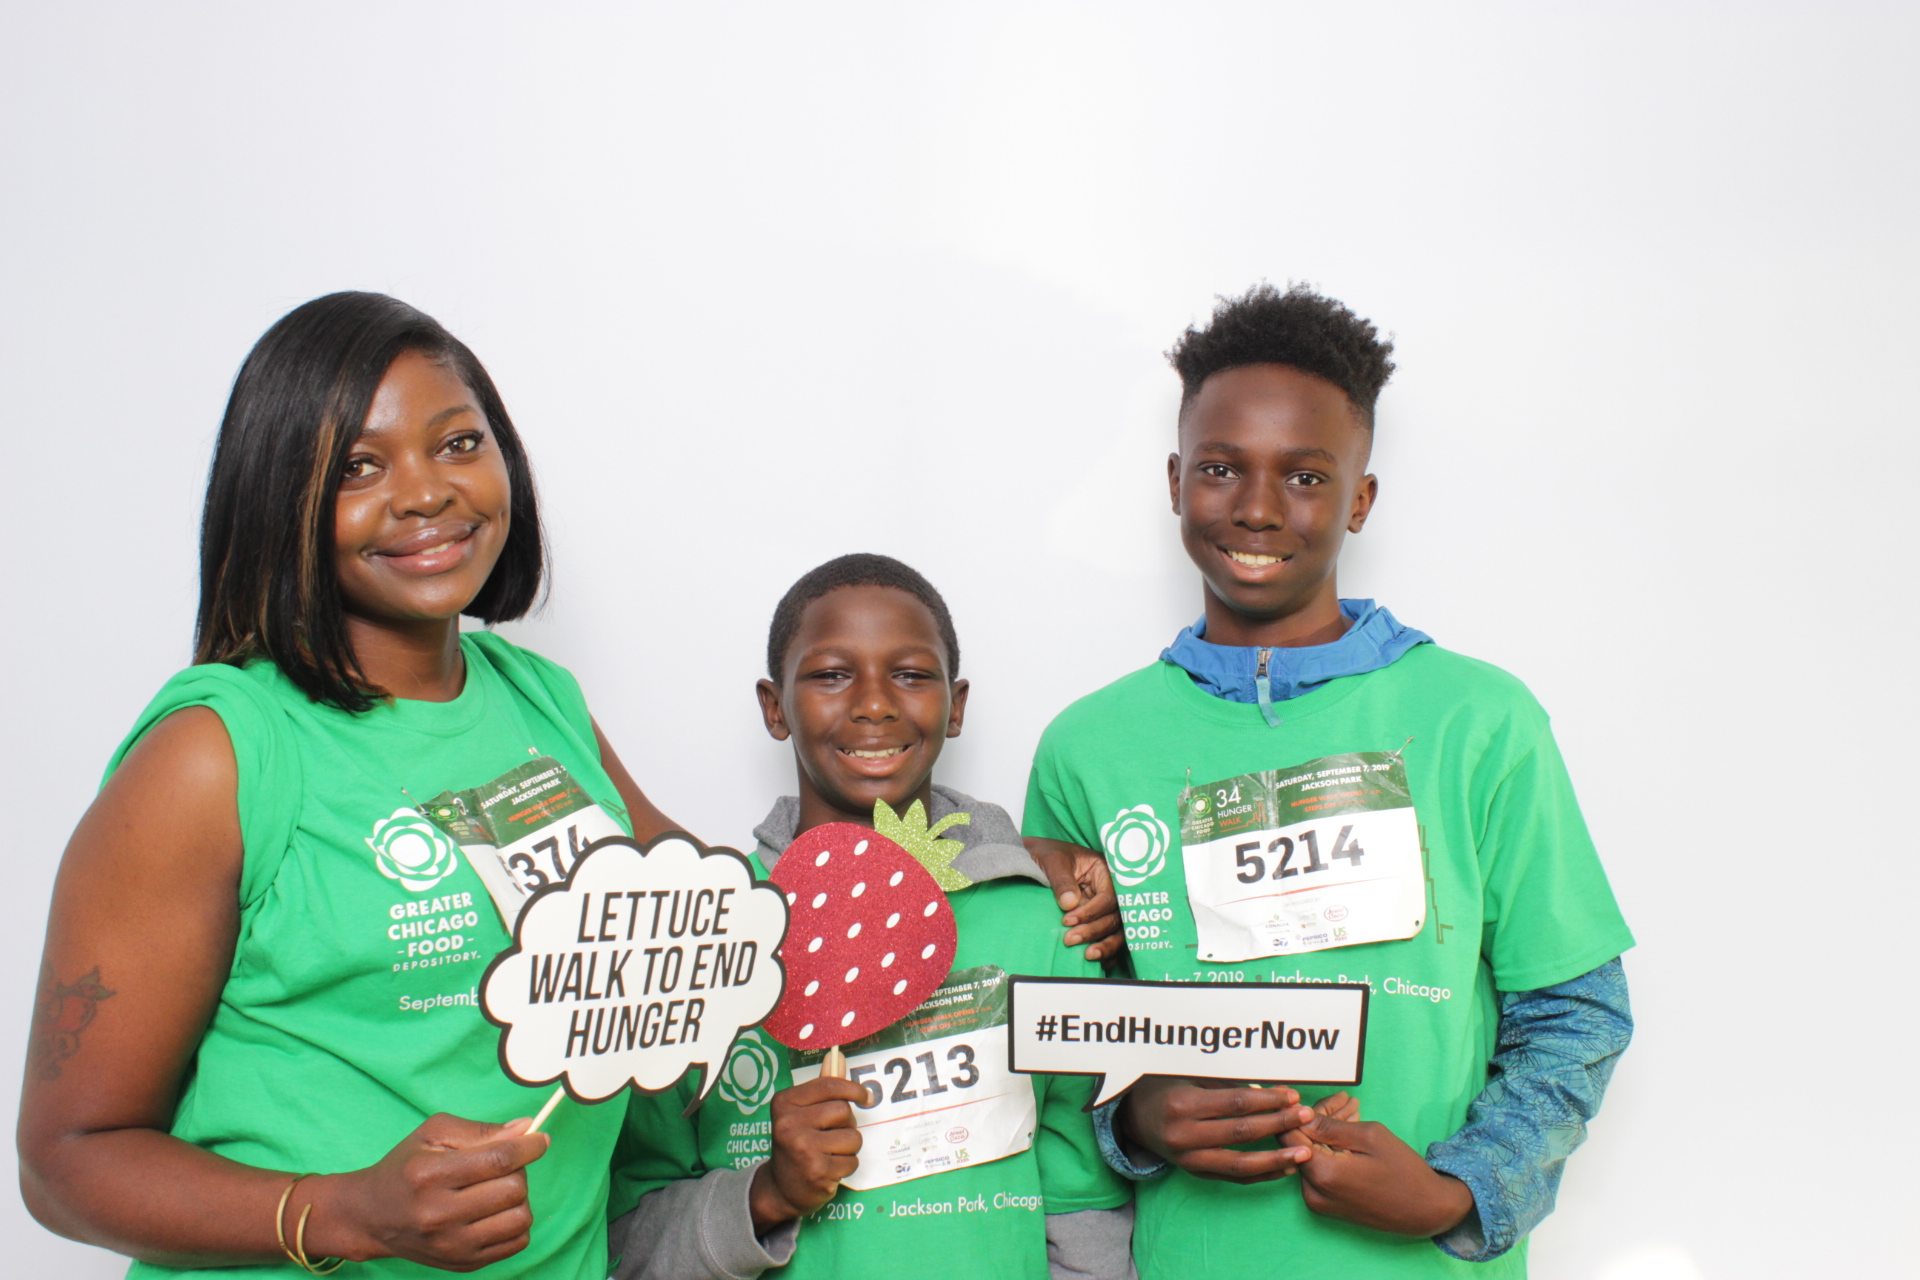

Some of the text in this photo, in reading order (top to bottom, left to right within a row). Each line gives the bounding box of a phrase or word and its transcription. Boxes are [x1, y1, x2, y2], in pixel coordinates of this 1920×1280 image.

[1275, 773, 1315, 789] SATURDAY,
[1316, 765, 1362, 779] SEPTEMBER
[1301, 775, 1363, 792] JACKSON PARK
[480, 785, 520, 810] SATURDAY,
[519, 769, 556, 790] SEPTEMBER
[511, 778, 562, 806] JACKSON PARK
[1217, 804, 1252, 818] HUNGER
[1290, 796, 1318, 807] HUNGER
[1191, 822, 1214, 831] CHICAGO
[1219, 816, 1242, 827] WALK
[1235, 824, 1365, 885] 5214
[389, 892, 473, 920] GREATER
[1117, 891, 1169, 907] REATER
[388, 911, 478, 940] CHICAGO
[577, 888, 736, 943] LETTUCE
[1121, 908, 1172, 923] ICAGO
[1125, 925, 1161, 940] OOD
[1302, 933, 1328, 941] PEPSICO
[1128, 941, 1170, 951] OSITORY
[528, 940, 758, 1004] WALK TO END
[931, 983, 972, 998] SEPTEMBER
[982, 977, 1001, 988] 2019
[953, 993, 975, 1004] PARK
[1383, 976, 1451, 1003] Chicago
[398, 986, 480, 1013] Septemb
[933, 1012, 953, 1021] WALK
[564, 998, 705, 1059] HUNGER
[1035, 1014, 1341, 1054] #EndHungerNow
[850, 1044, 980, 1110] 5213
[726, 1138, 772, 1153] CHICAG
[827, 1202, 864, 1220] 2019
[889, 1198, 952, 1218] Jackson
[958, 1193, 988, 1213] Park,
